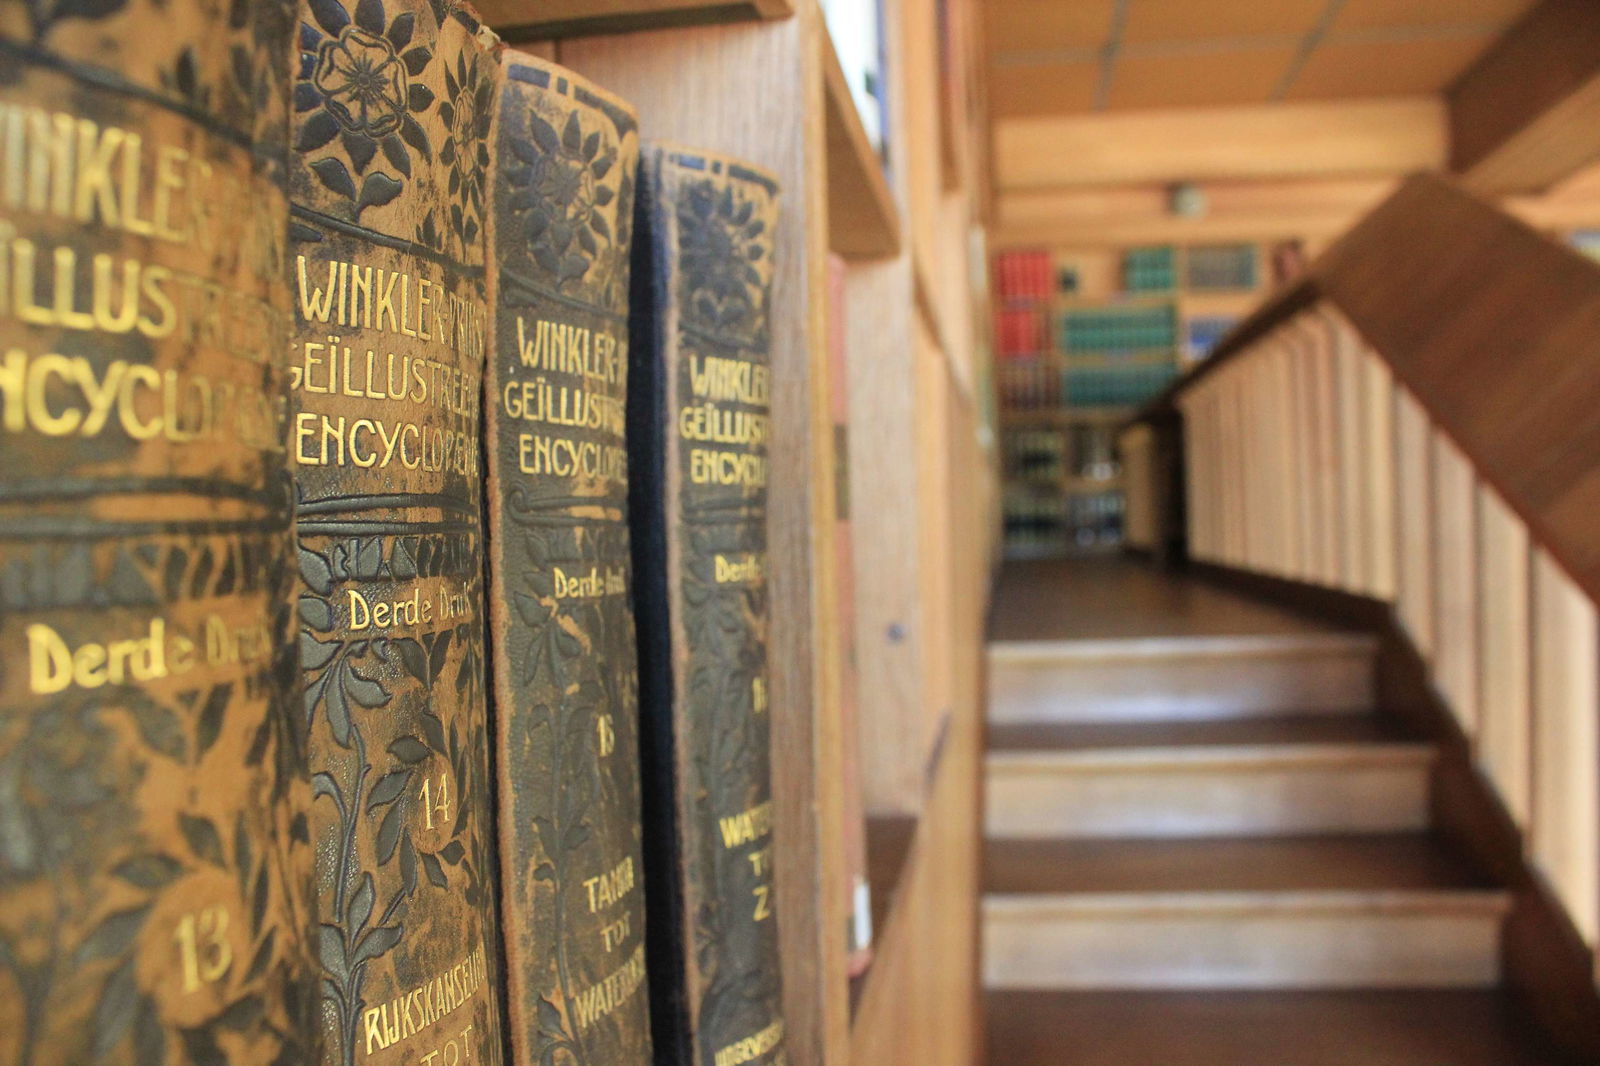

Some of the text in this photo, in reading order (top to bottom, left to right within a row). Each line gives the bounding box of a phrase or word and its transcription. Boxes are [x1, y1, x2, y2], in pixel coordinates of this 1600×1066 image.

[553, 567, 605, 599] Derde
[348, 588, 432, 631] Derde
[27, 616, 194, 694] Derde
[419, 772, 451, 831] 14
[752, 885, 770, 921] Z
[174, 904, 232, 993] 13
[600, 911, 631, 953] TOT
